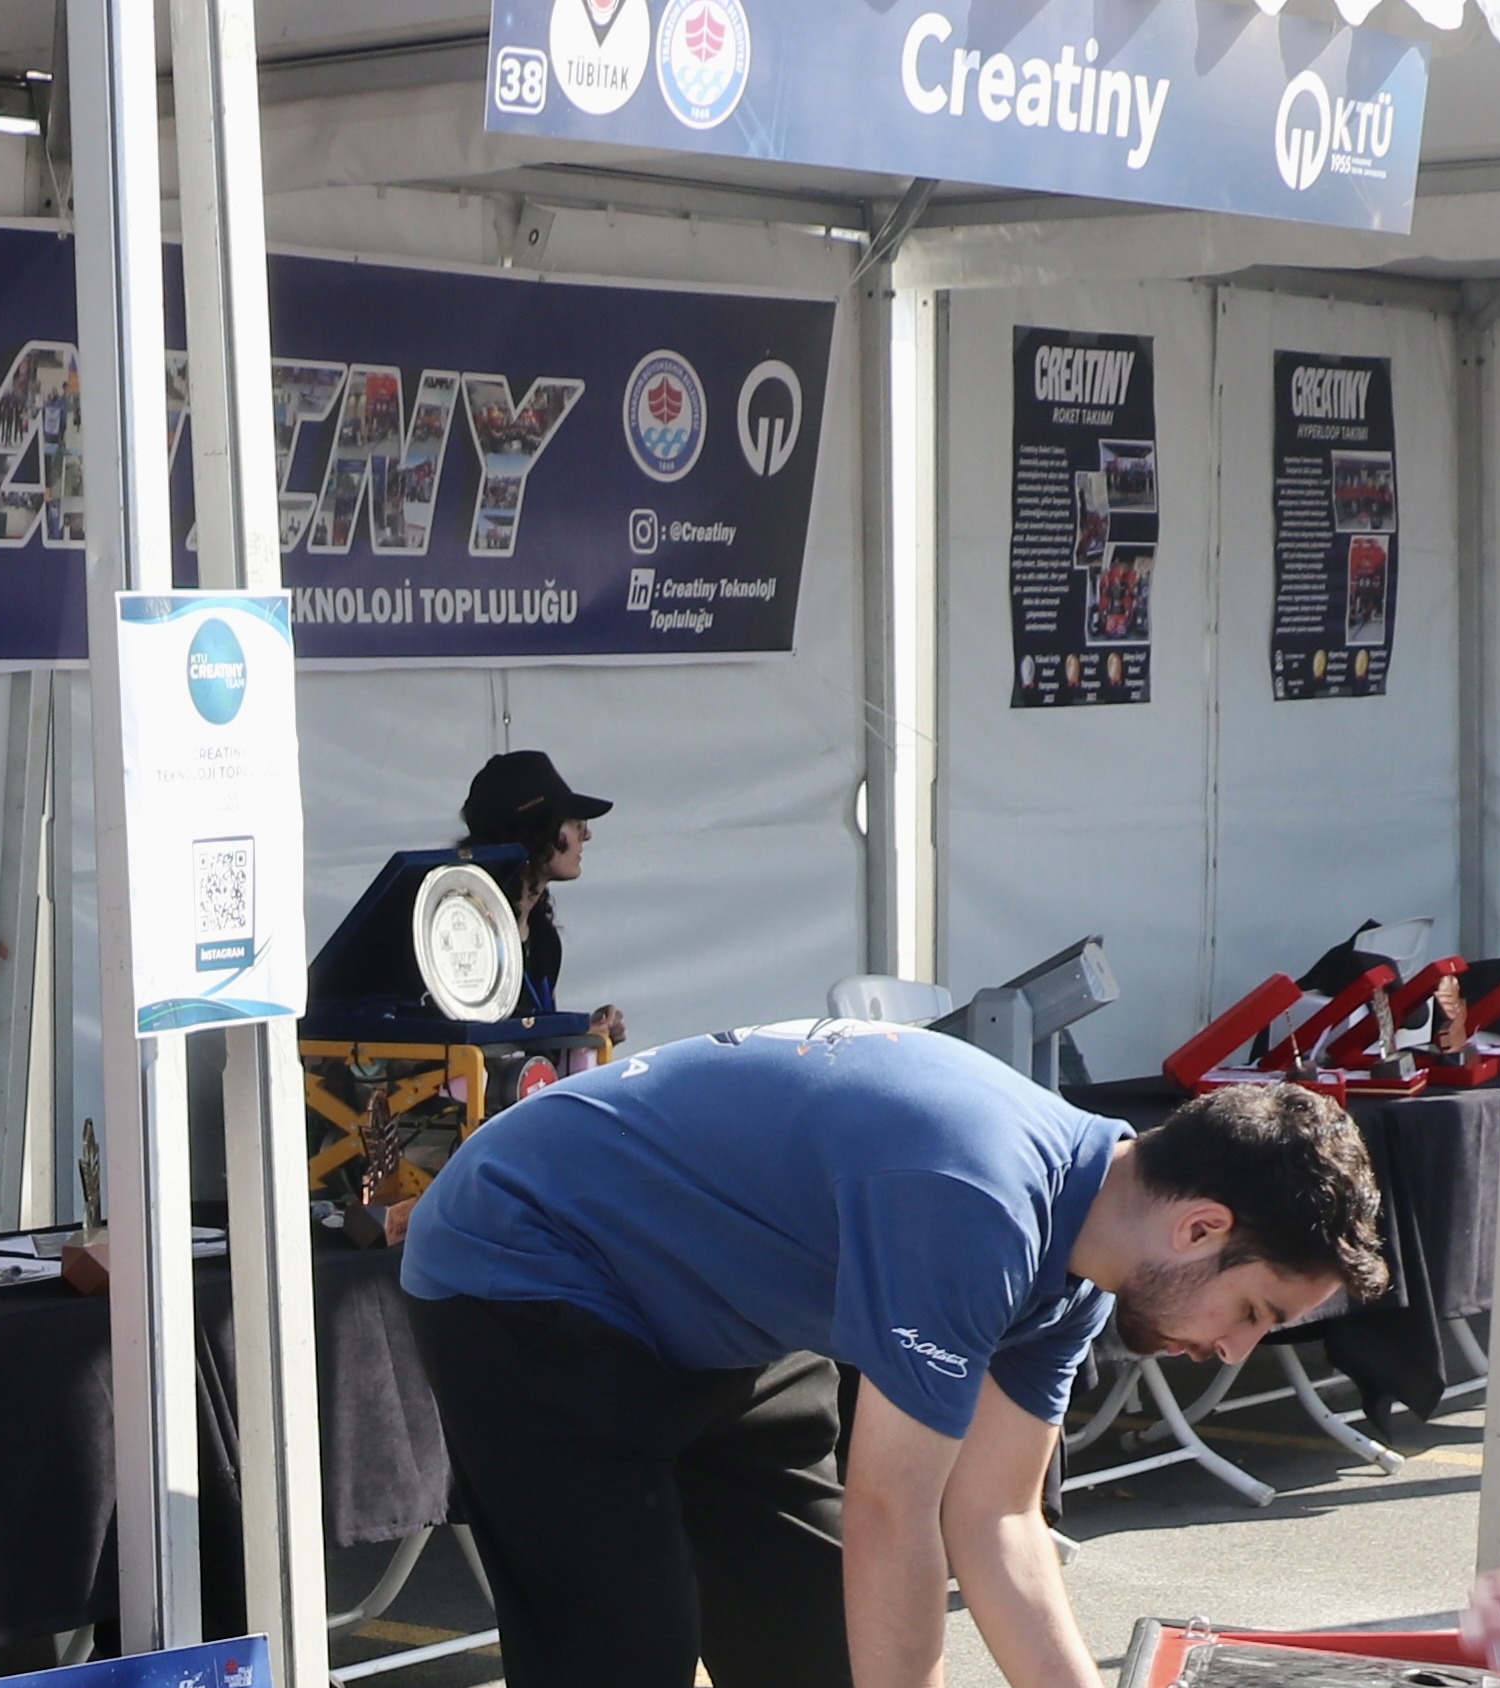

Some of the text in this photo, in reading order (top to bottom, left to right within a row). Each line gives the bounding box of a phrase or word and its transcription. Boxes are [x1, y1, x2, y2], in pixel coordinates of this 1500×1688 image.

[499, 57, 543, 104] 38
[567, 56, 629, 91] TÜBİTAK
[901, 11, 1170, 170] Creatiny
[1332, 91, 1394, 158] KTÜ
[1330, 153, 1351, 174] 1955
[1034, 345, 1136, 406] CREATINY
[1291, 366, 1373, 421] CREATINY
[1052, 407, 1115, 427] ROKET TAKIMI
[670, 521, 737, 546] @Creatiny
[419, 578, 578, 624] TOPLULUĞU
[662, 577, 777, 602] Creatiny Teknoloji
[650, 607, 714, 633] Topluluğu
[190, 652, 208, 664] KTU
[189, 663, 243, 680] CREATINY
[224, 678, 245, 690] TEAM
